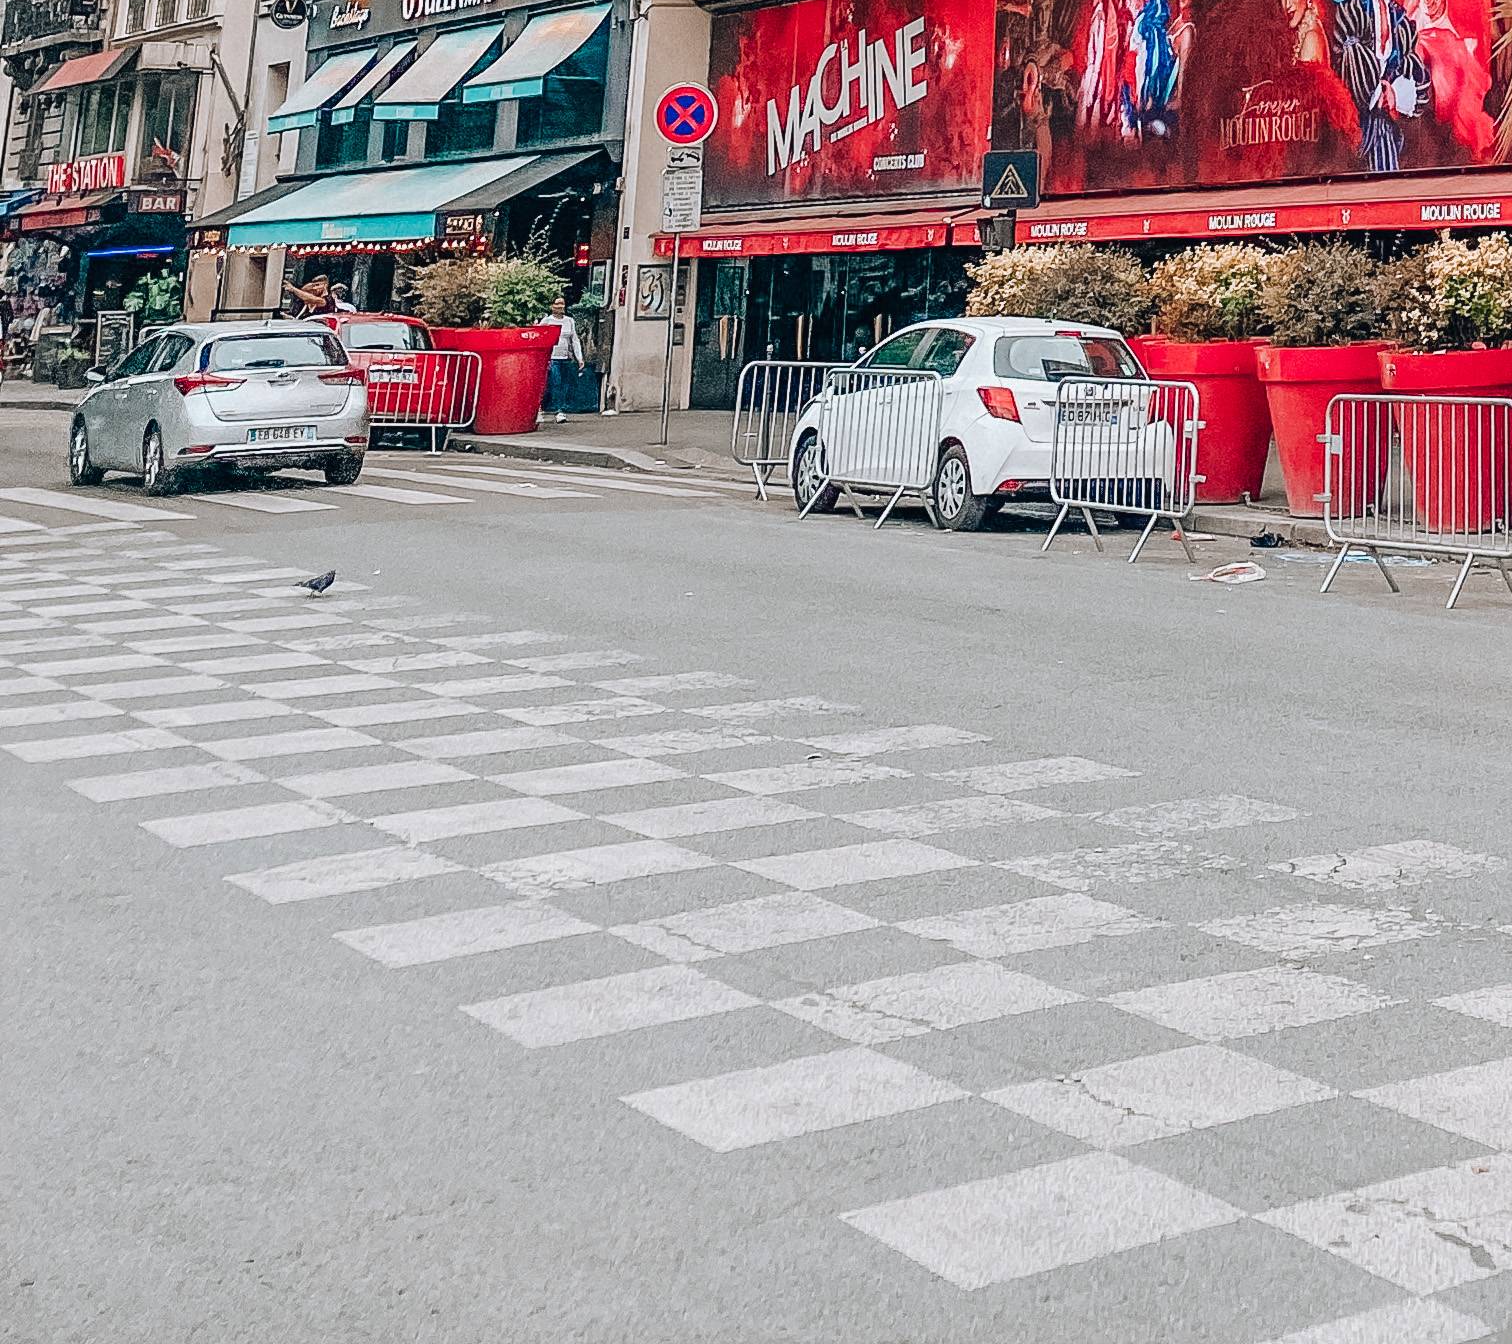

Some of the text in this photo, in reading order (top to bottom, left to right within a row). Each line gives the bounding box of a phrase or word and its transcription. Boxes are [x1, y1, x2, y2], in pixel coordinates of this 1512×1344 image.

[766, 15, 928, 177] MACHINE
[1235, 79, 1301, 118] Forever
[1220, 108, 1320, 151] MOULIN ROUGE
[47, 156, 119, 194] THE STATION
[140, 195, 178, 211] BAR
[1420, 203, 1501, 221] MOULIN ROUGE
[1030, 222, 1088, 238] MOULIN ROUGE
[1208, 212, 1276, 231] MOULIN ROUGE
